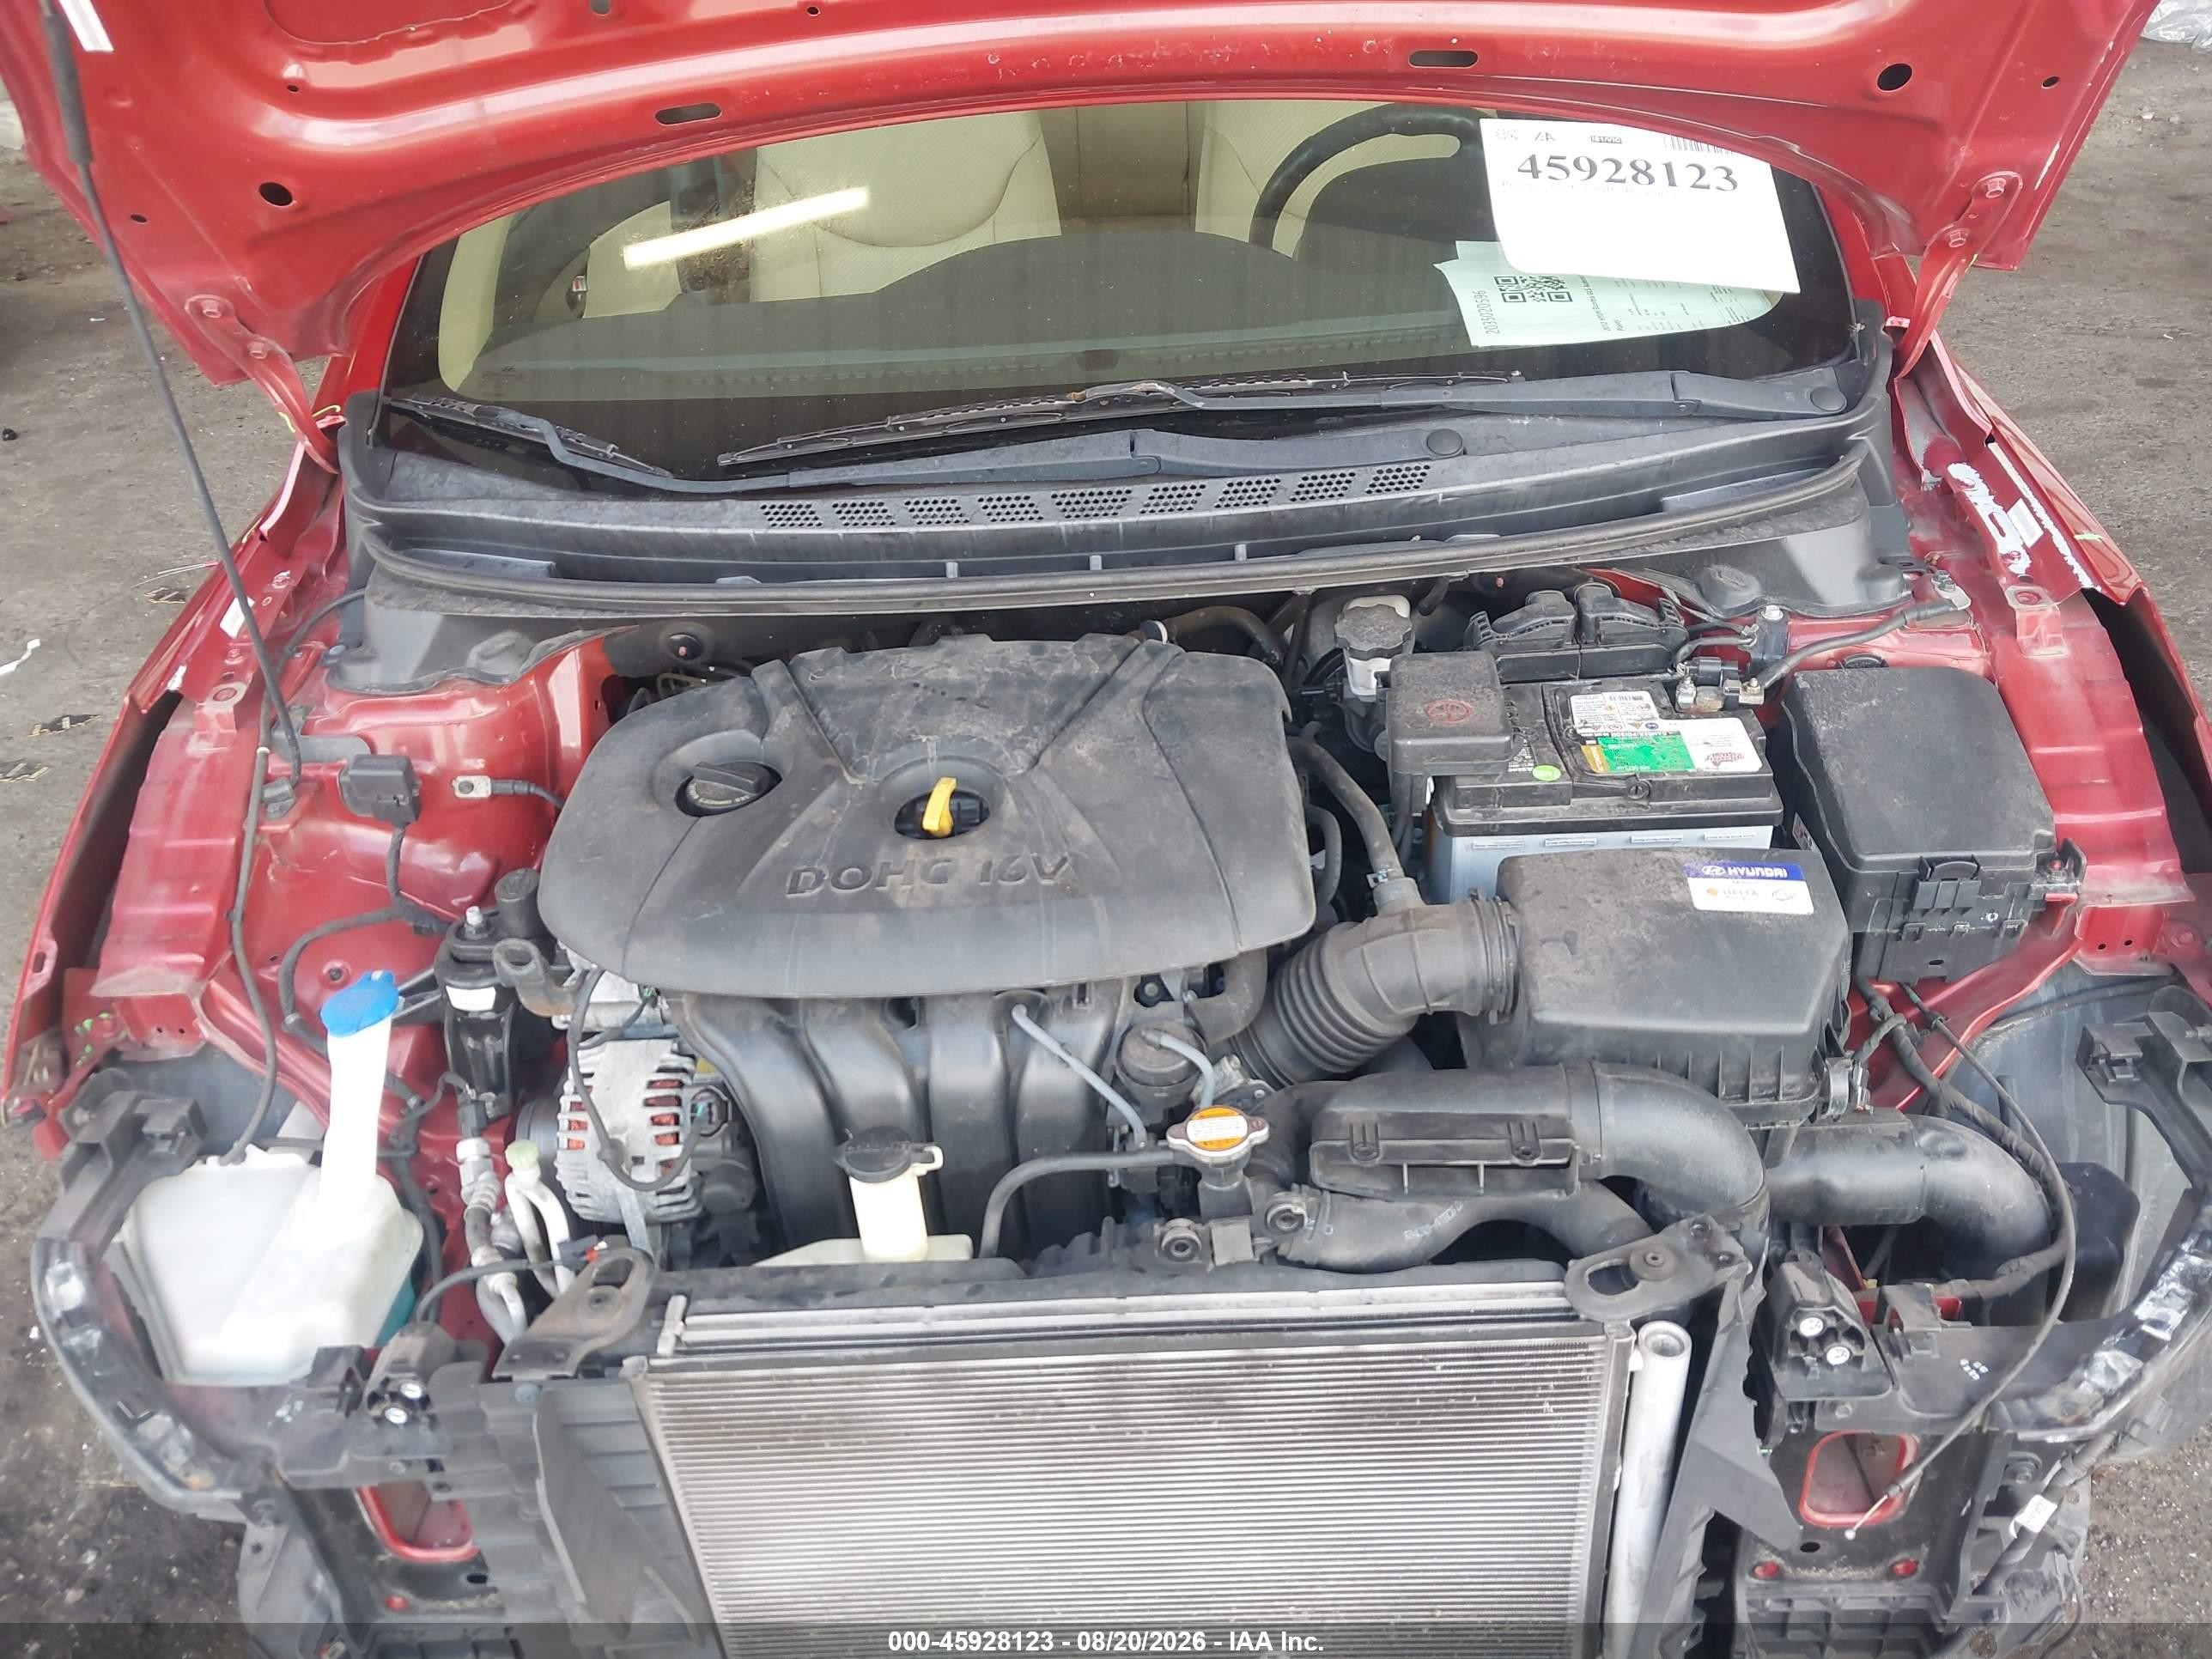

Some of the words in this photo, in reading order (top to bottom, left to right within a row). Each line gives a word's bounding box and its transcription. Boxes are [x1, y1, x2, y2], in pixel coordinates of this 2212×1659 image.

[1517, 154, 1738, 191] 45928123
[1472, 289, 1501, 335] 2035020596
[786, 858, 954, 898] DOHC
[979, 854, 1072, 886] 16V
[1727, 866, 1788, 878] HYUNDAI
